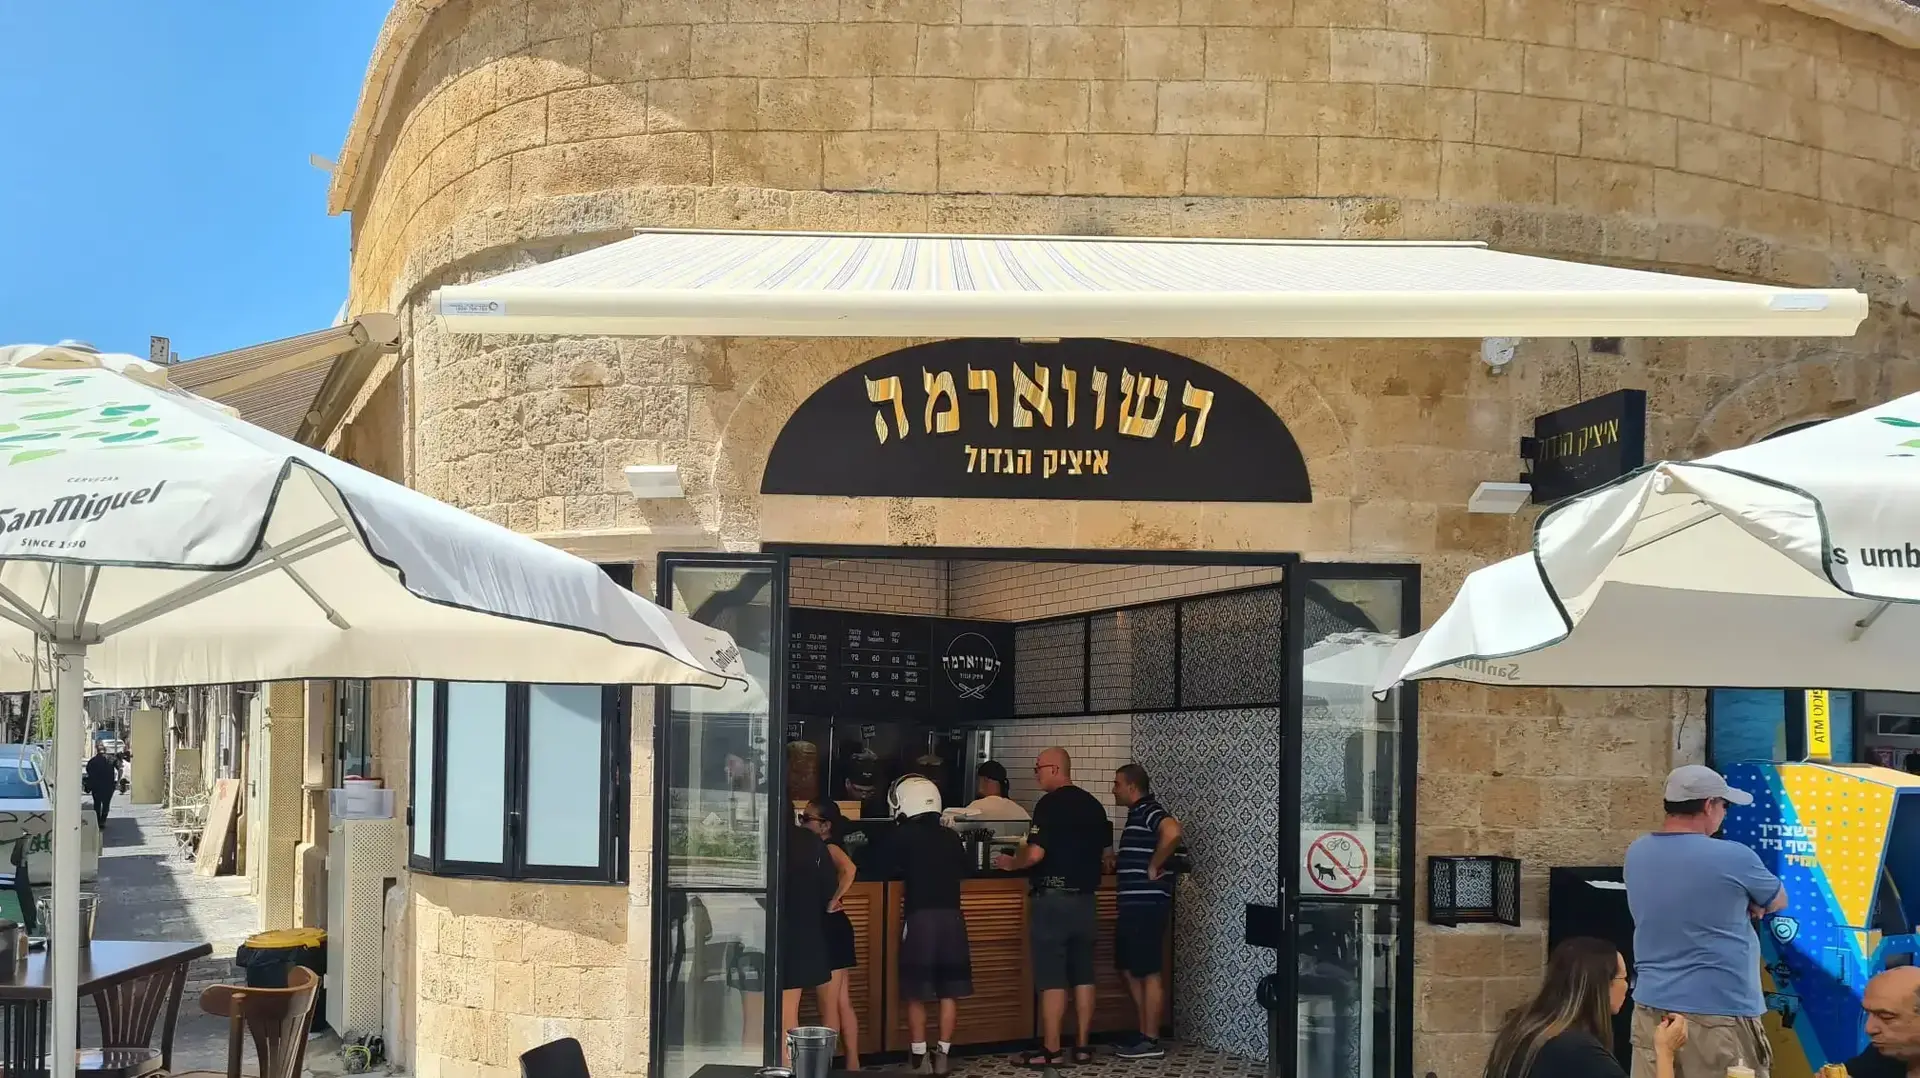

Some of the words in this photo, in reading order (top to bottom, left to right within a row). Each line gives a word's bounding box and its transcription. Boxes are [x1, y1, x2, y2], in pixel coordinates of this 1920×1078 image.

[864, 361, 1214, 447] השווארמה
[1578, 419, 1619, 456] איציק
[964, 444, 1032, 474] הגדול
[1043, 448, 1110, 479] איציק
[21, 538, 55, 549] SINCE
[1830, 547, 1849, 566] s
[942, 655, 1002, 673] השווארמה
[1814, 720, 1825, 743] ATM
[1758, 824, 1818, 838] כשצריך
[1759, 838, 1783, 851] ביד
[1785, 839, 1817, 854] כסף
